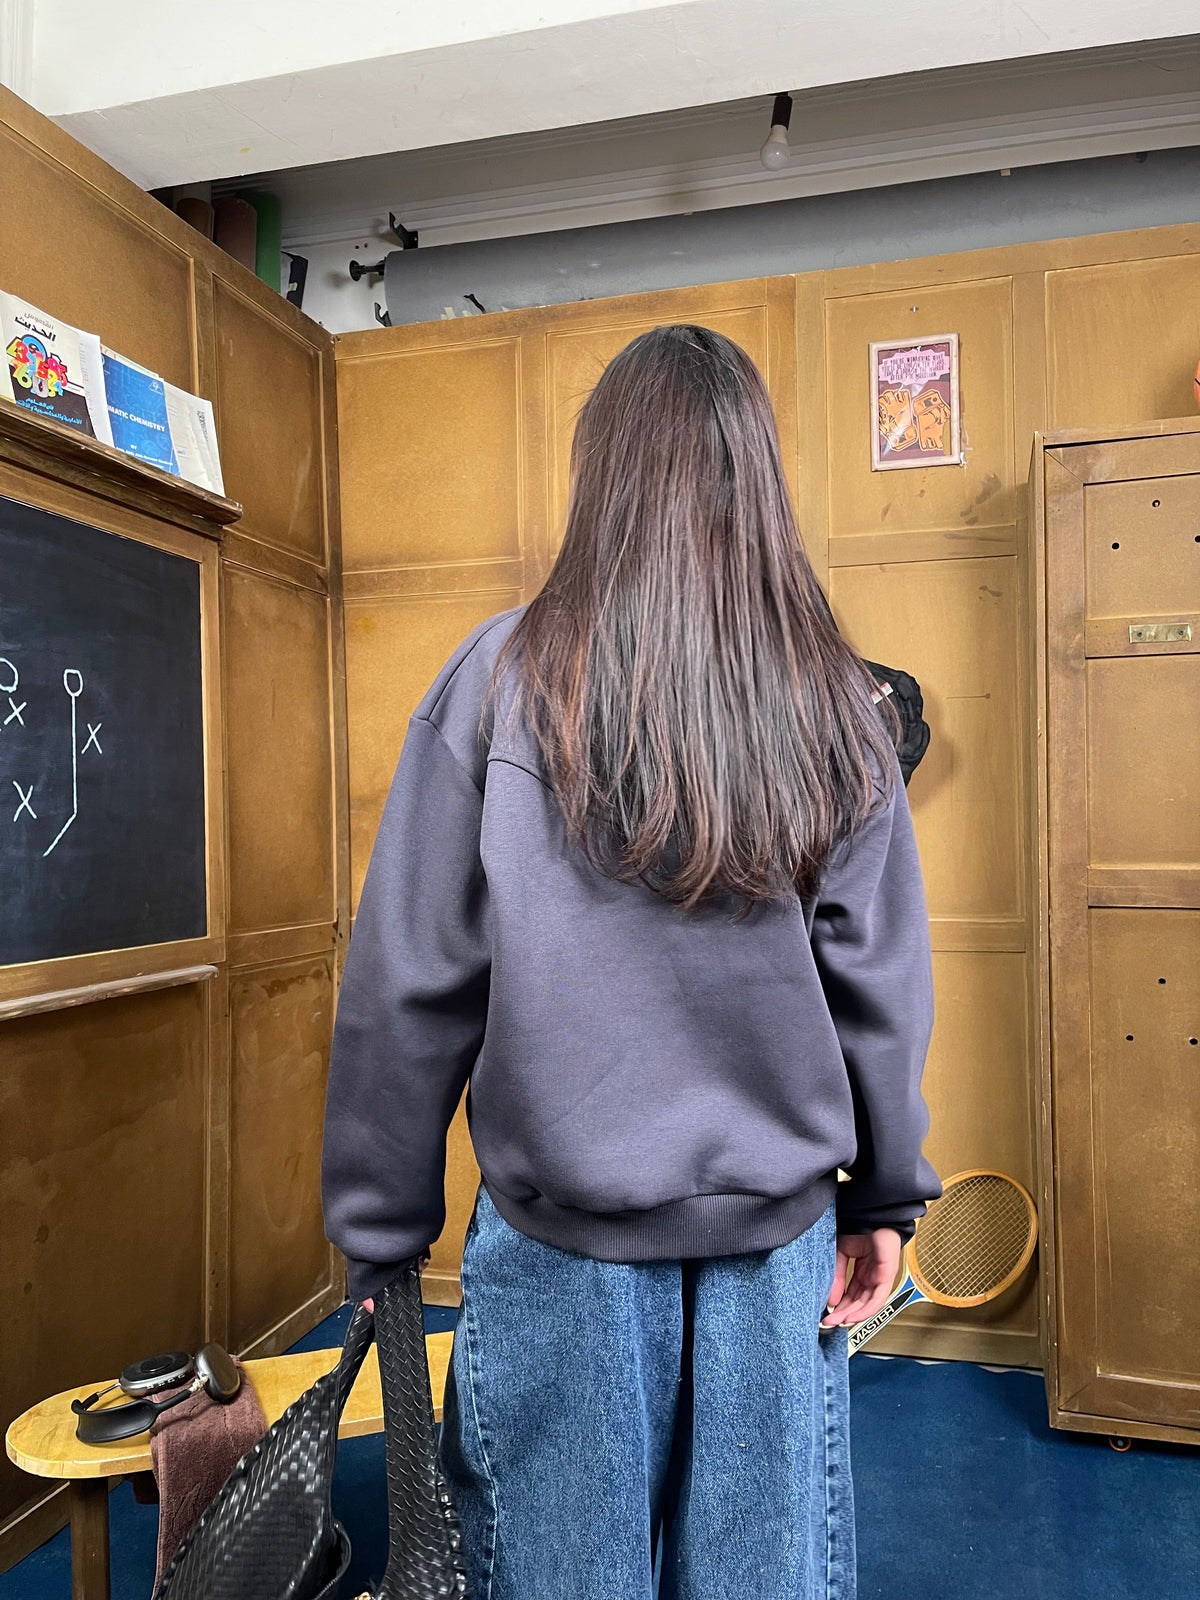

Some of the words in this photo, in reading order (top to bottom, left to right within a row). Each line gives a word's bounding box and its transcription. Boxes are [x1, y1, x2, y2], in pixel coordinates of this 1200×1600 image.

[15, 316, 56, 342] الحديث
[129, 413, 165, 432] CHEMISTRY
[849, 1304, 896, 1348] MASTER
